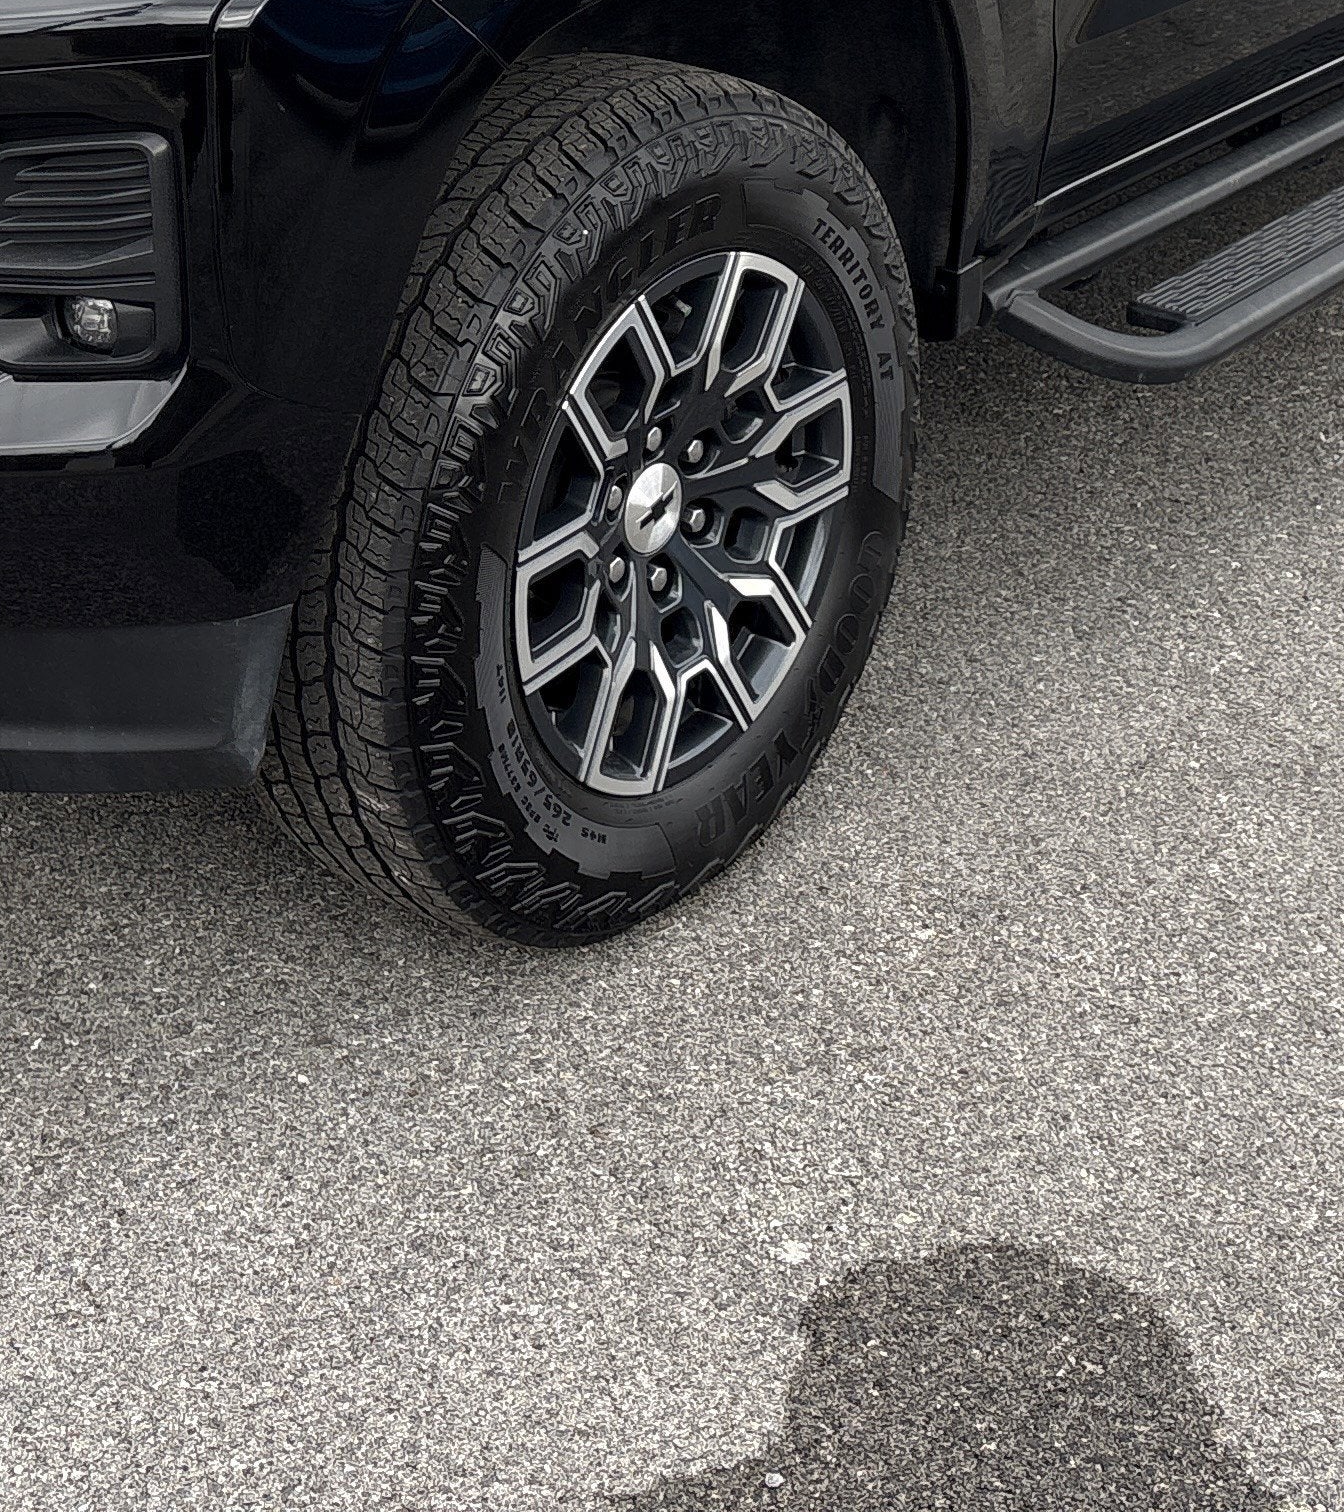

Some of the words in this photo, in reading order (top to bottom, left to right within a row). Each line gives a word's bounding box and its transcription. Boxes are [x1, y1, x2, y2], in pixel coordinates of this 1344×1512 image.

[810, 216, 884, 336] TERRITORY
[876, 344, 893, 387] AT
[695, 529, 890, 854] GOODYEAR
